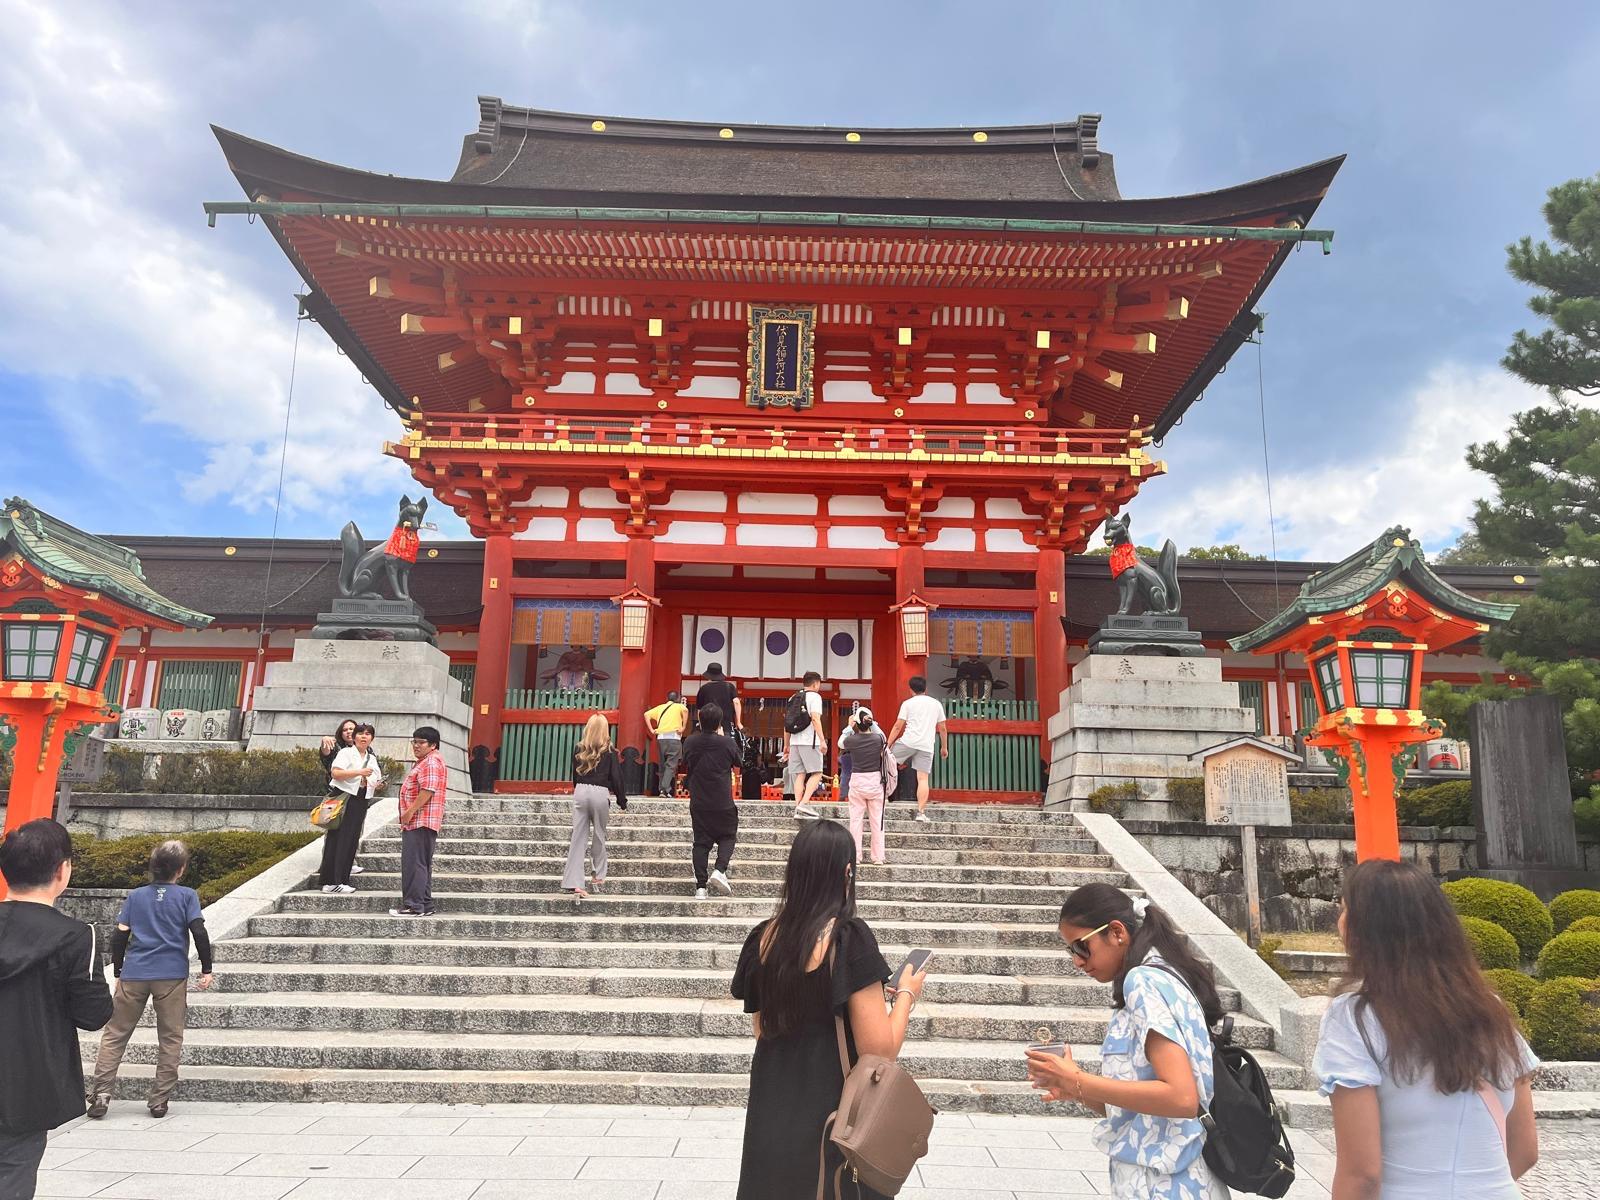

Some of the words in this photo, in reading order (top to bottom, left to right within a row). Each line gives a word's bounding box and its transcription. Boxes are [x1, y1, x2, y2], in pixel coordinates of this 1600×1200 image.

[776, 325, 788, 389] 伏見稲荷大社
